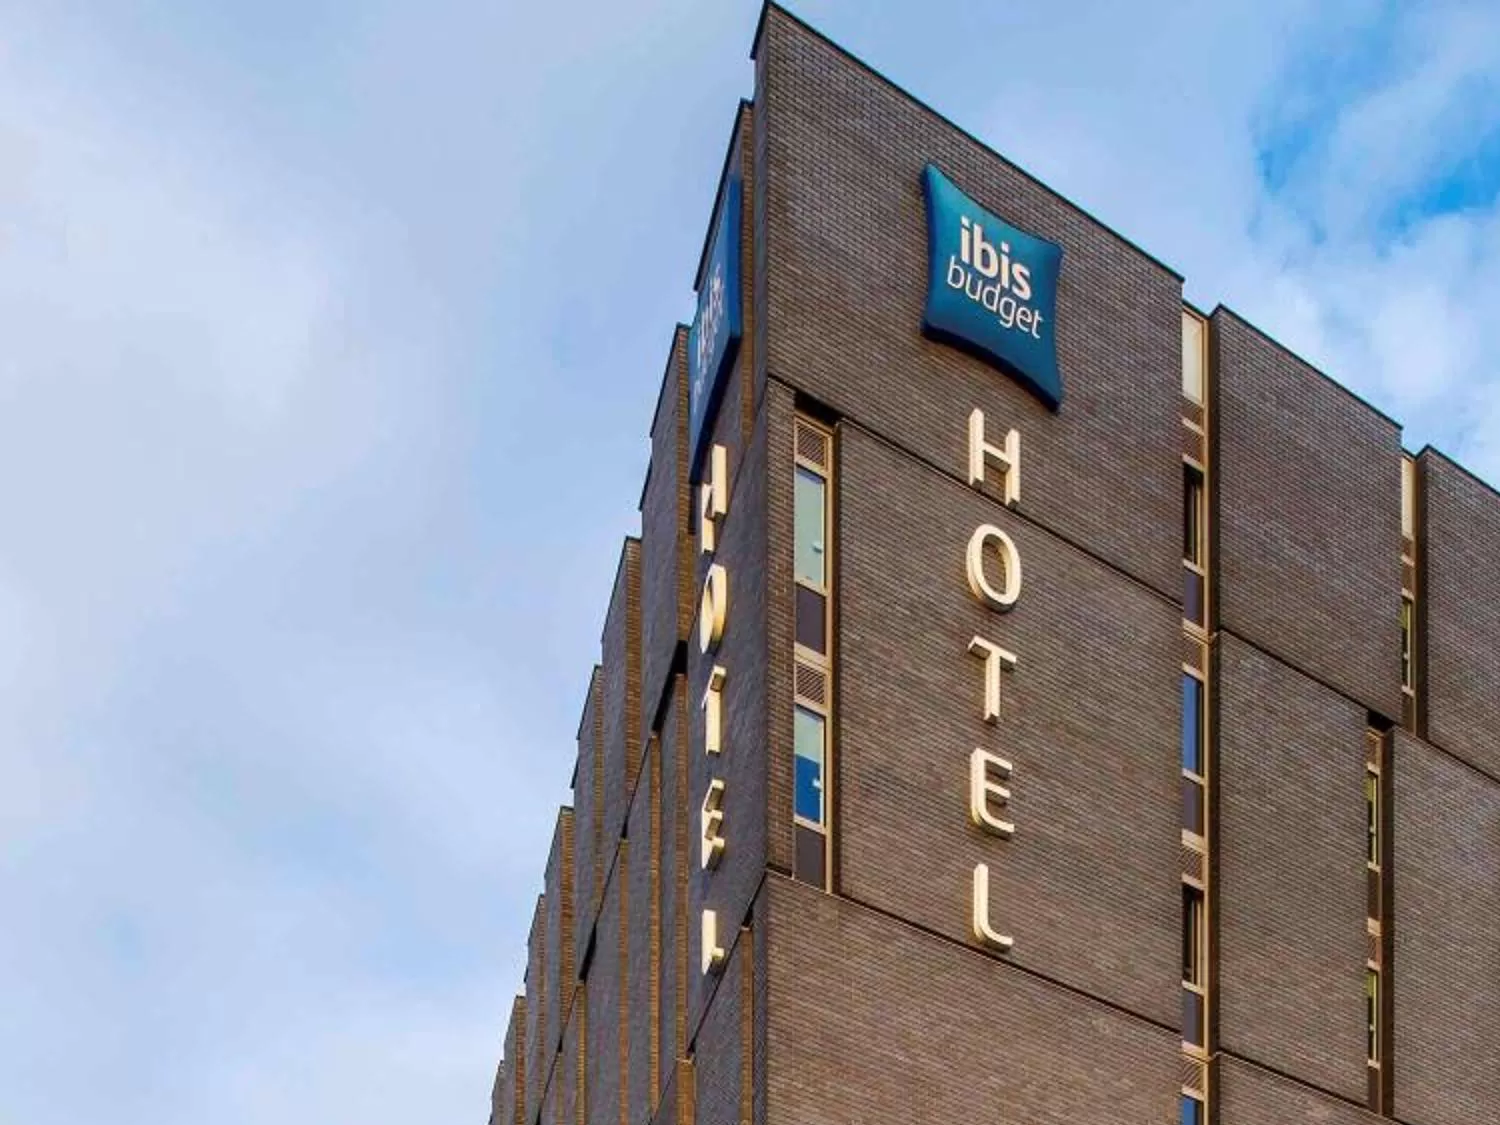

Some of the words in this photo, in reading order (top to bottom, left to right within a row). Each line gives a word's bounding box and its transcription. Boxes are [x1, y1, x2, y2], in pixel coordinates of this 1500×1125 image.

[947, 255, 1043, 339] budget
[961, 216, 1032, 300] ibis
[965, 407, 1022, 951] HOTEL
